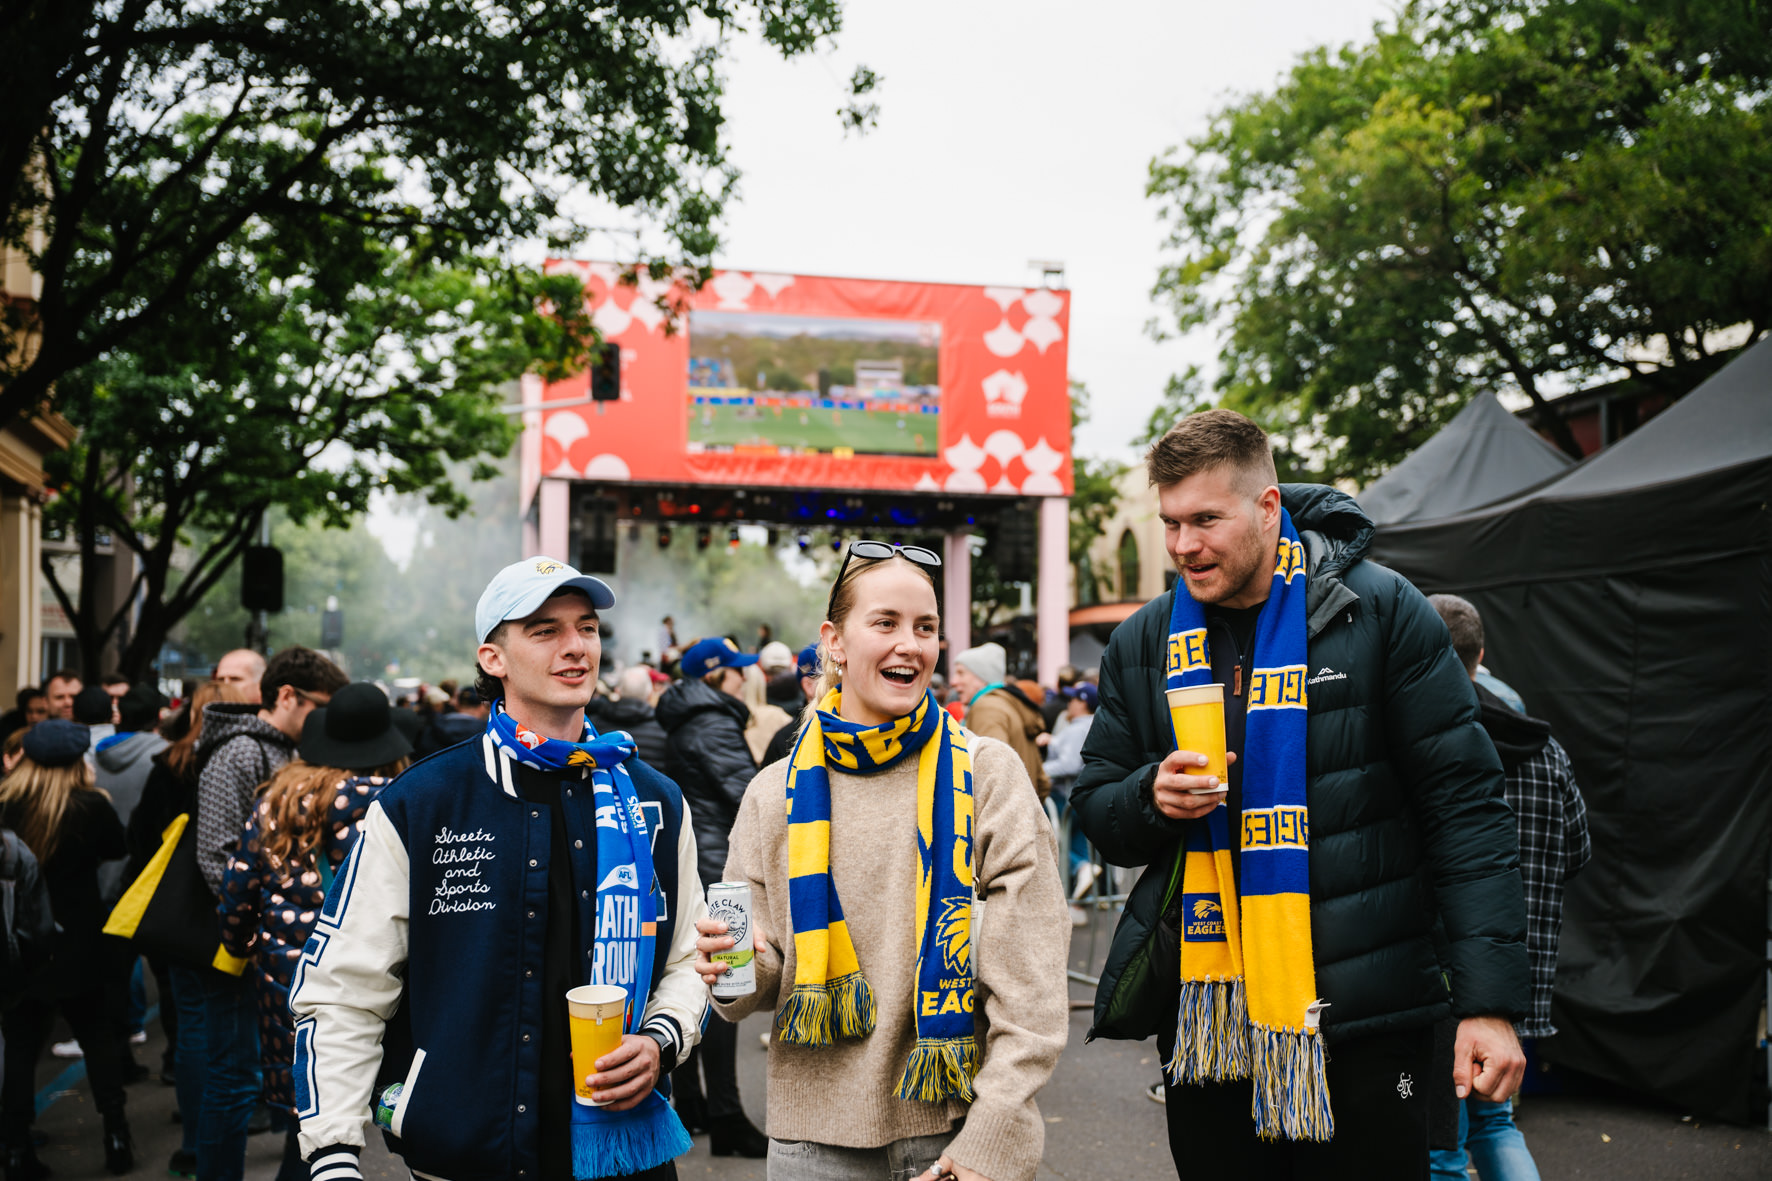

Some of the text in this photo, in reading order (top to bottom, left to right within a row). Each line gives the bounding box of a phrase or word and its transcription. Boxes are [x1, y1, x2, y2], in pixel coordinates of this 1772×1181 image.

[434, 826, 496, 844] Streetx
[432, 846, 496, 865] Athletic
[444, 861, 482, 878] and
[618, 870, 632, 880] AFL
[434, 878, 491, 900] Sports
[428, 898, 497, 915] Division
[708, 898, 746, 920] HITE CLAW
[594, 894, 641, 940] ATH
[1187, 925, 1226, 935] EAGLES
[590, 940, 639, 986] ROUN
[939, 977, 972, 990] WEST
[920, 988, 975, 1017] EAG
